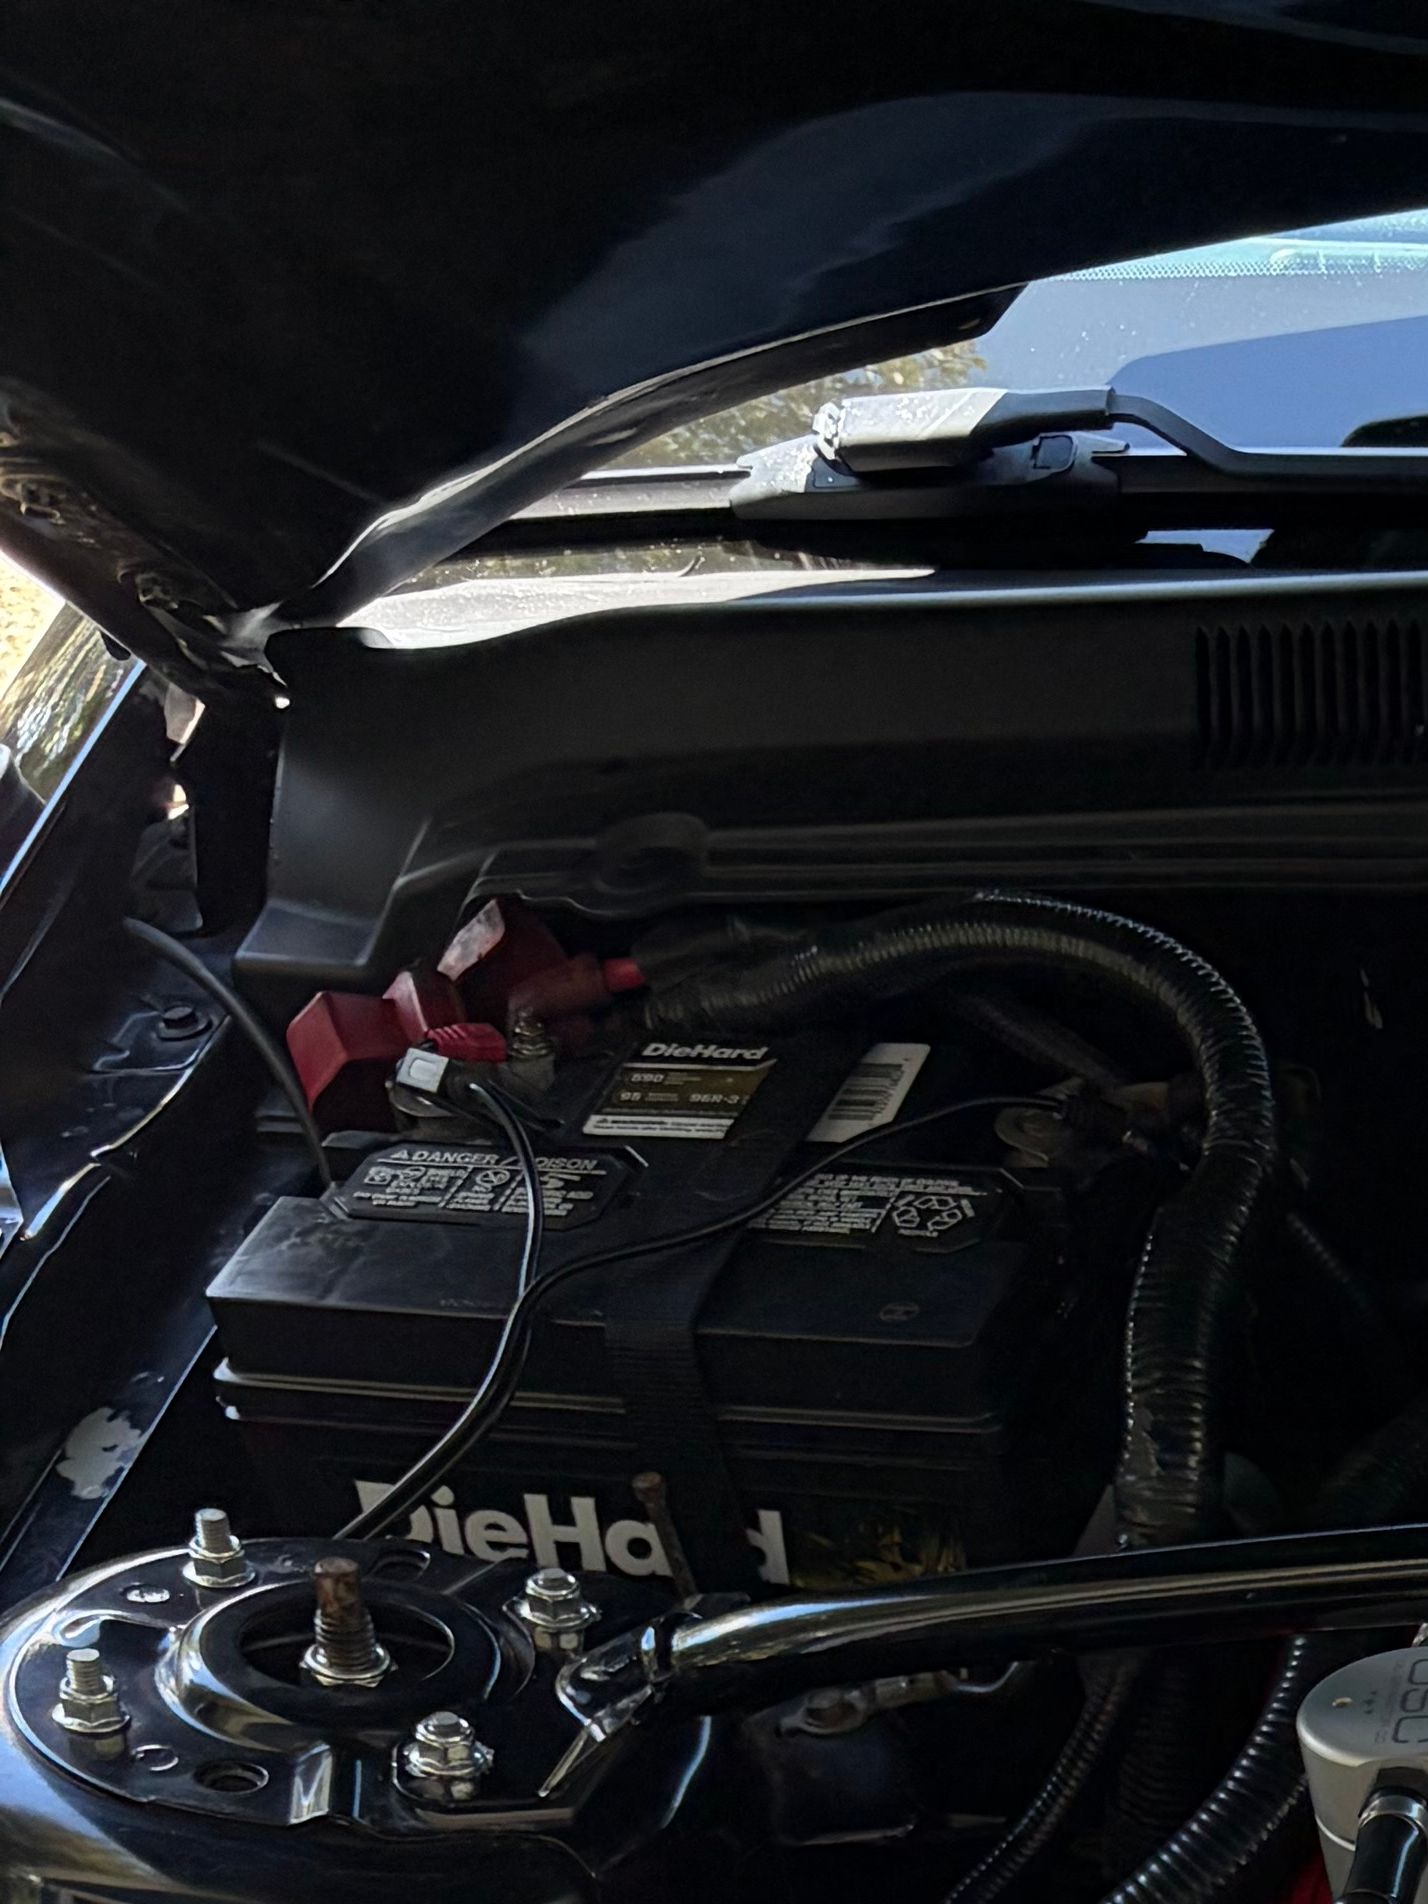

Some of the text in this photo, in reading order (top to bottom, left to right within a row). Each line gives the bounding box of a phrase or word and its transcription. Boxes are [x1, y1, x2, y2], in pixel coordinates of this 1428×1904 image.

[640, 1043, 768, 1061] DieHard
[409, 1150, 499, 1165] DANGER
[354, 1479, 790, 1586] DieHad
